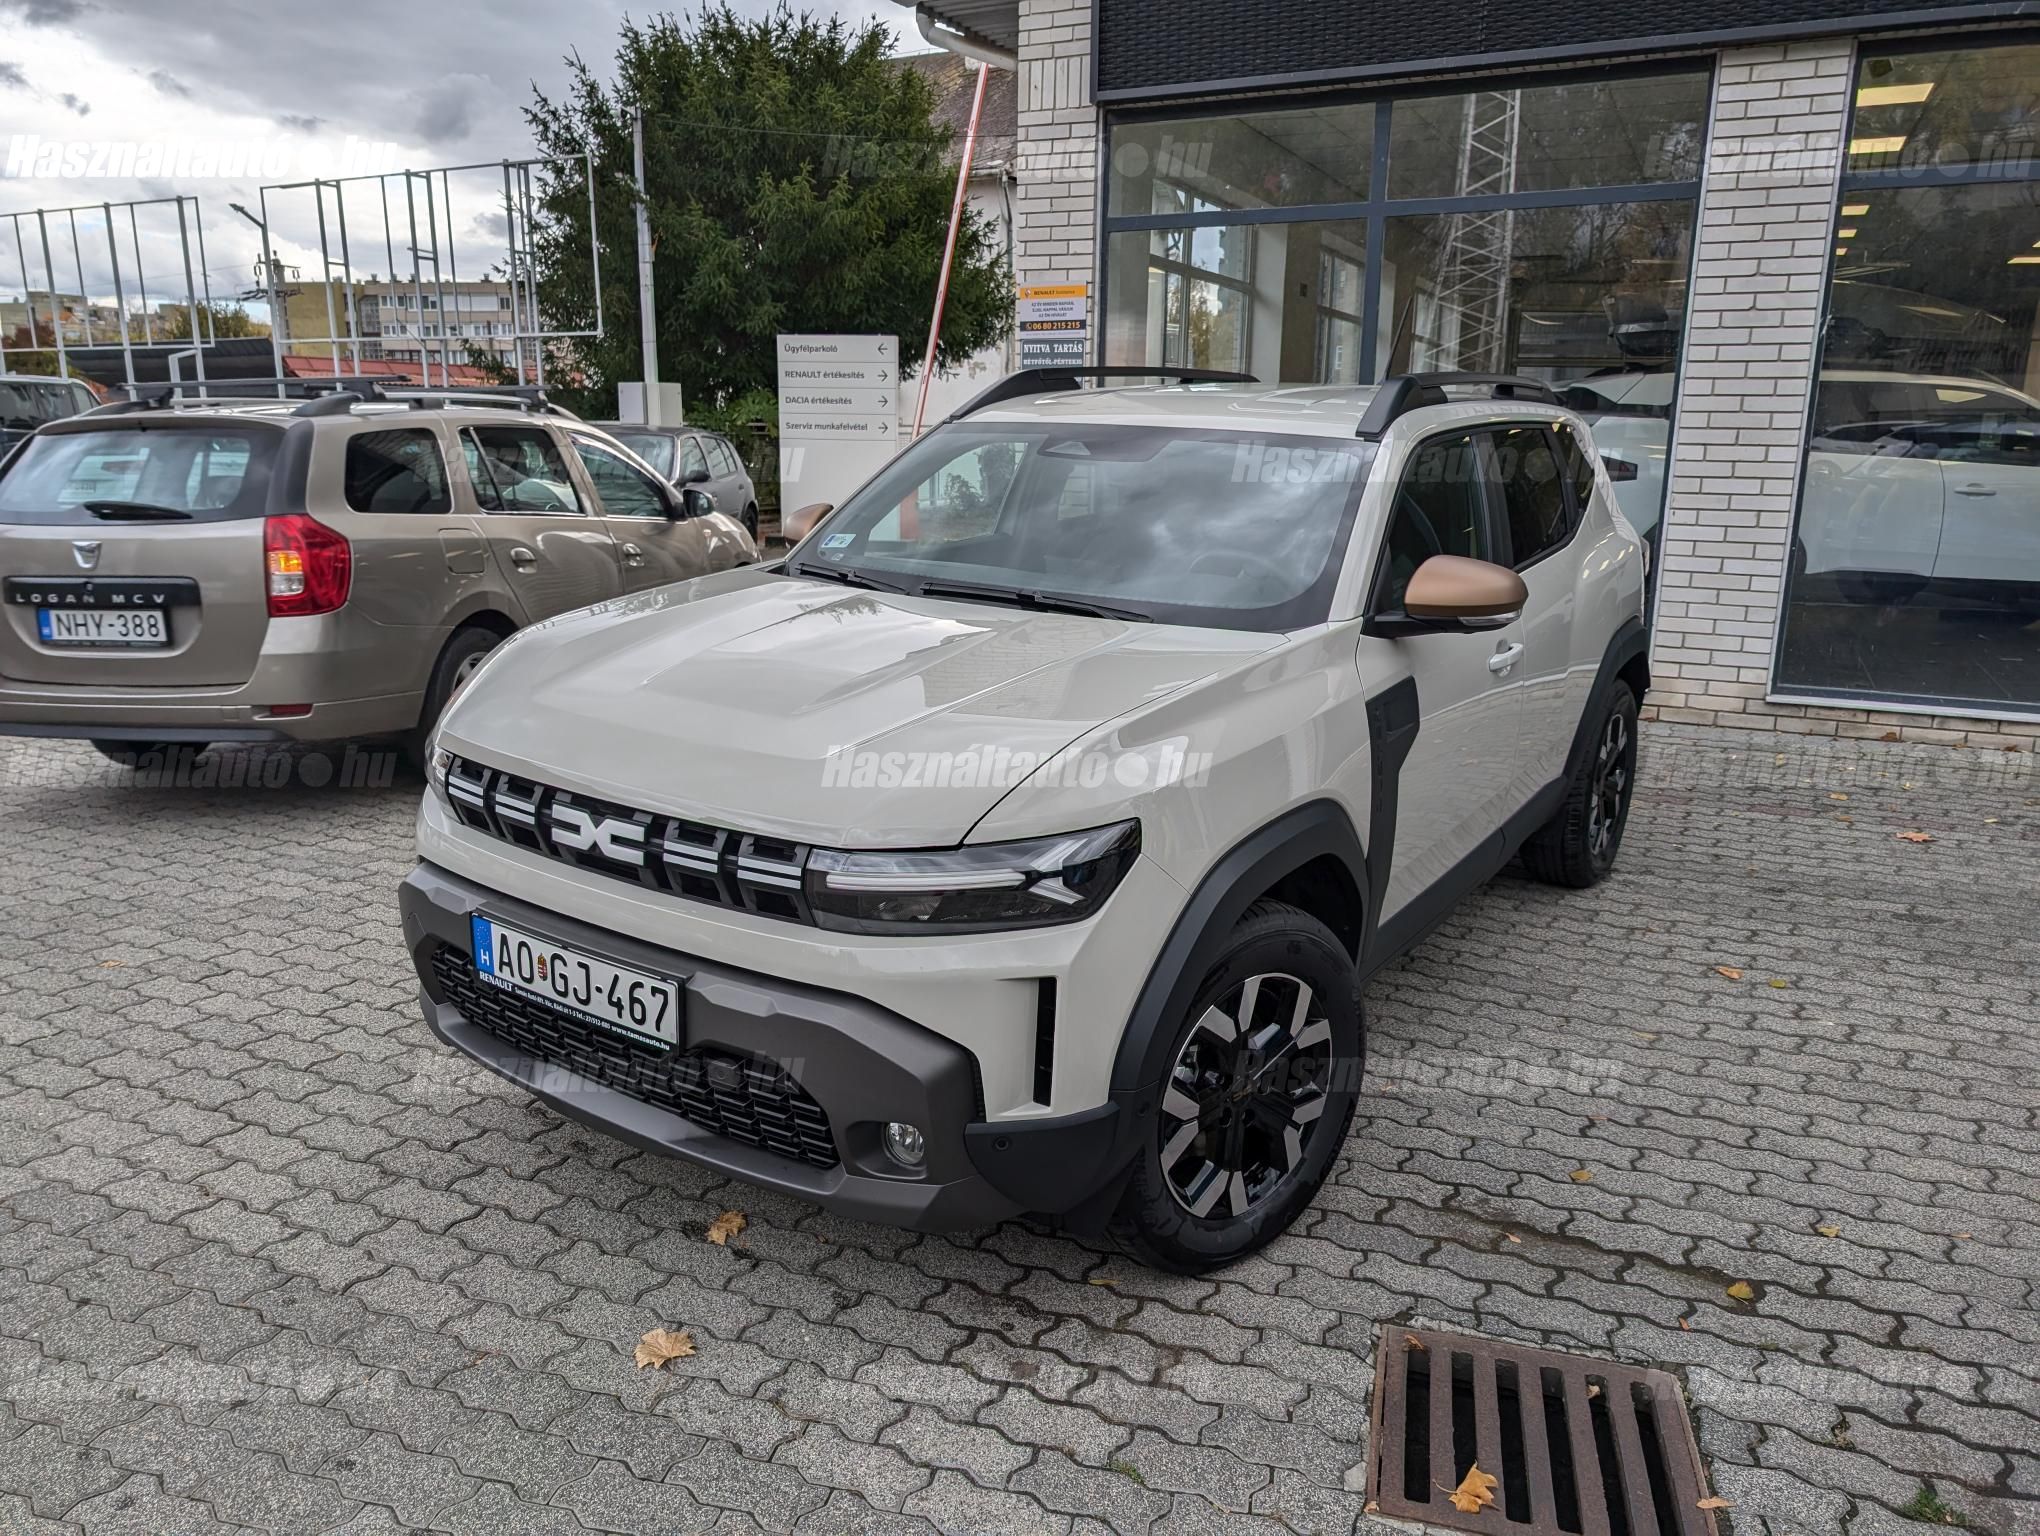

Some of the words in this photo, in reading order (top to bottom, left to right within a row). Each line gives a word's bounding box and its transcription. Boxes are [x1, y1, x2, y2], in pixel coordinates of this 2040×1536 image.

[784, 343, 838, 354] Ügyfélparkoló
[1024, 344, 1050, 353] NYITVA
[1053, 341, 1082, 352] TARTÁS
[823, 371, 865, 379] értékesítés
[811, 397, 852, 405] értékesítés
[785, 422, 813, 430] Szerviz
[814, 423, 868, 431] munkafelvétel
[15, 593, 95, 603] LOGAN
[111, 593, 166, 603] MCV
[55, 613, 161, 638] NHY-388
[480, 949, 490, 967] H
[479, 970, 513, 992] RENAULT
[611, 1025, 670, 1051] www.tamasauto.hu
